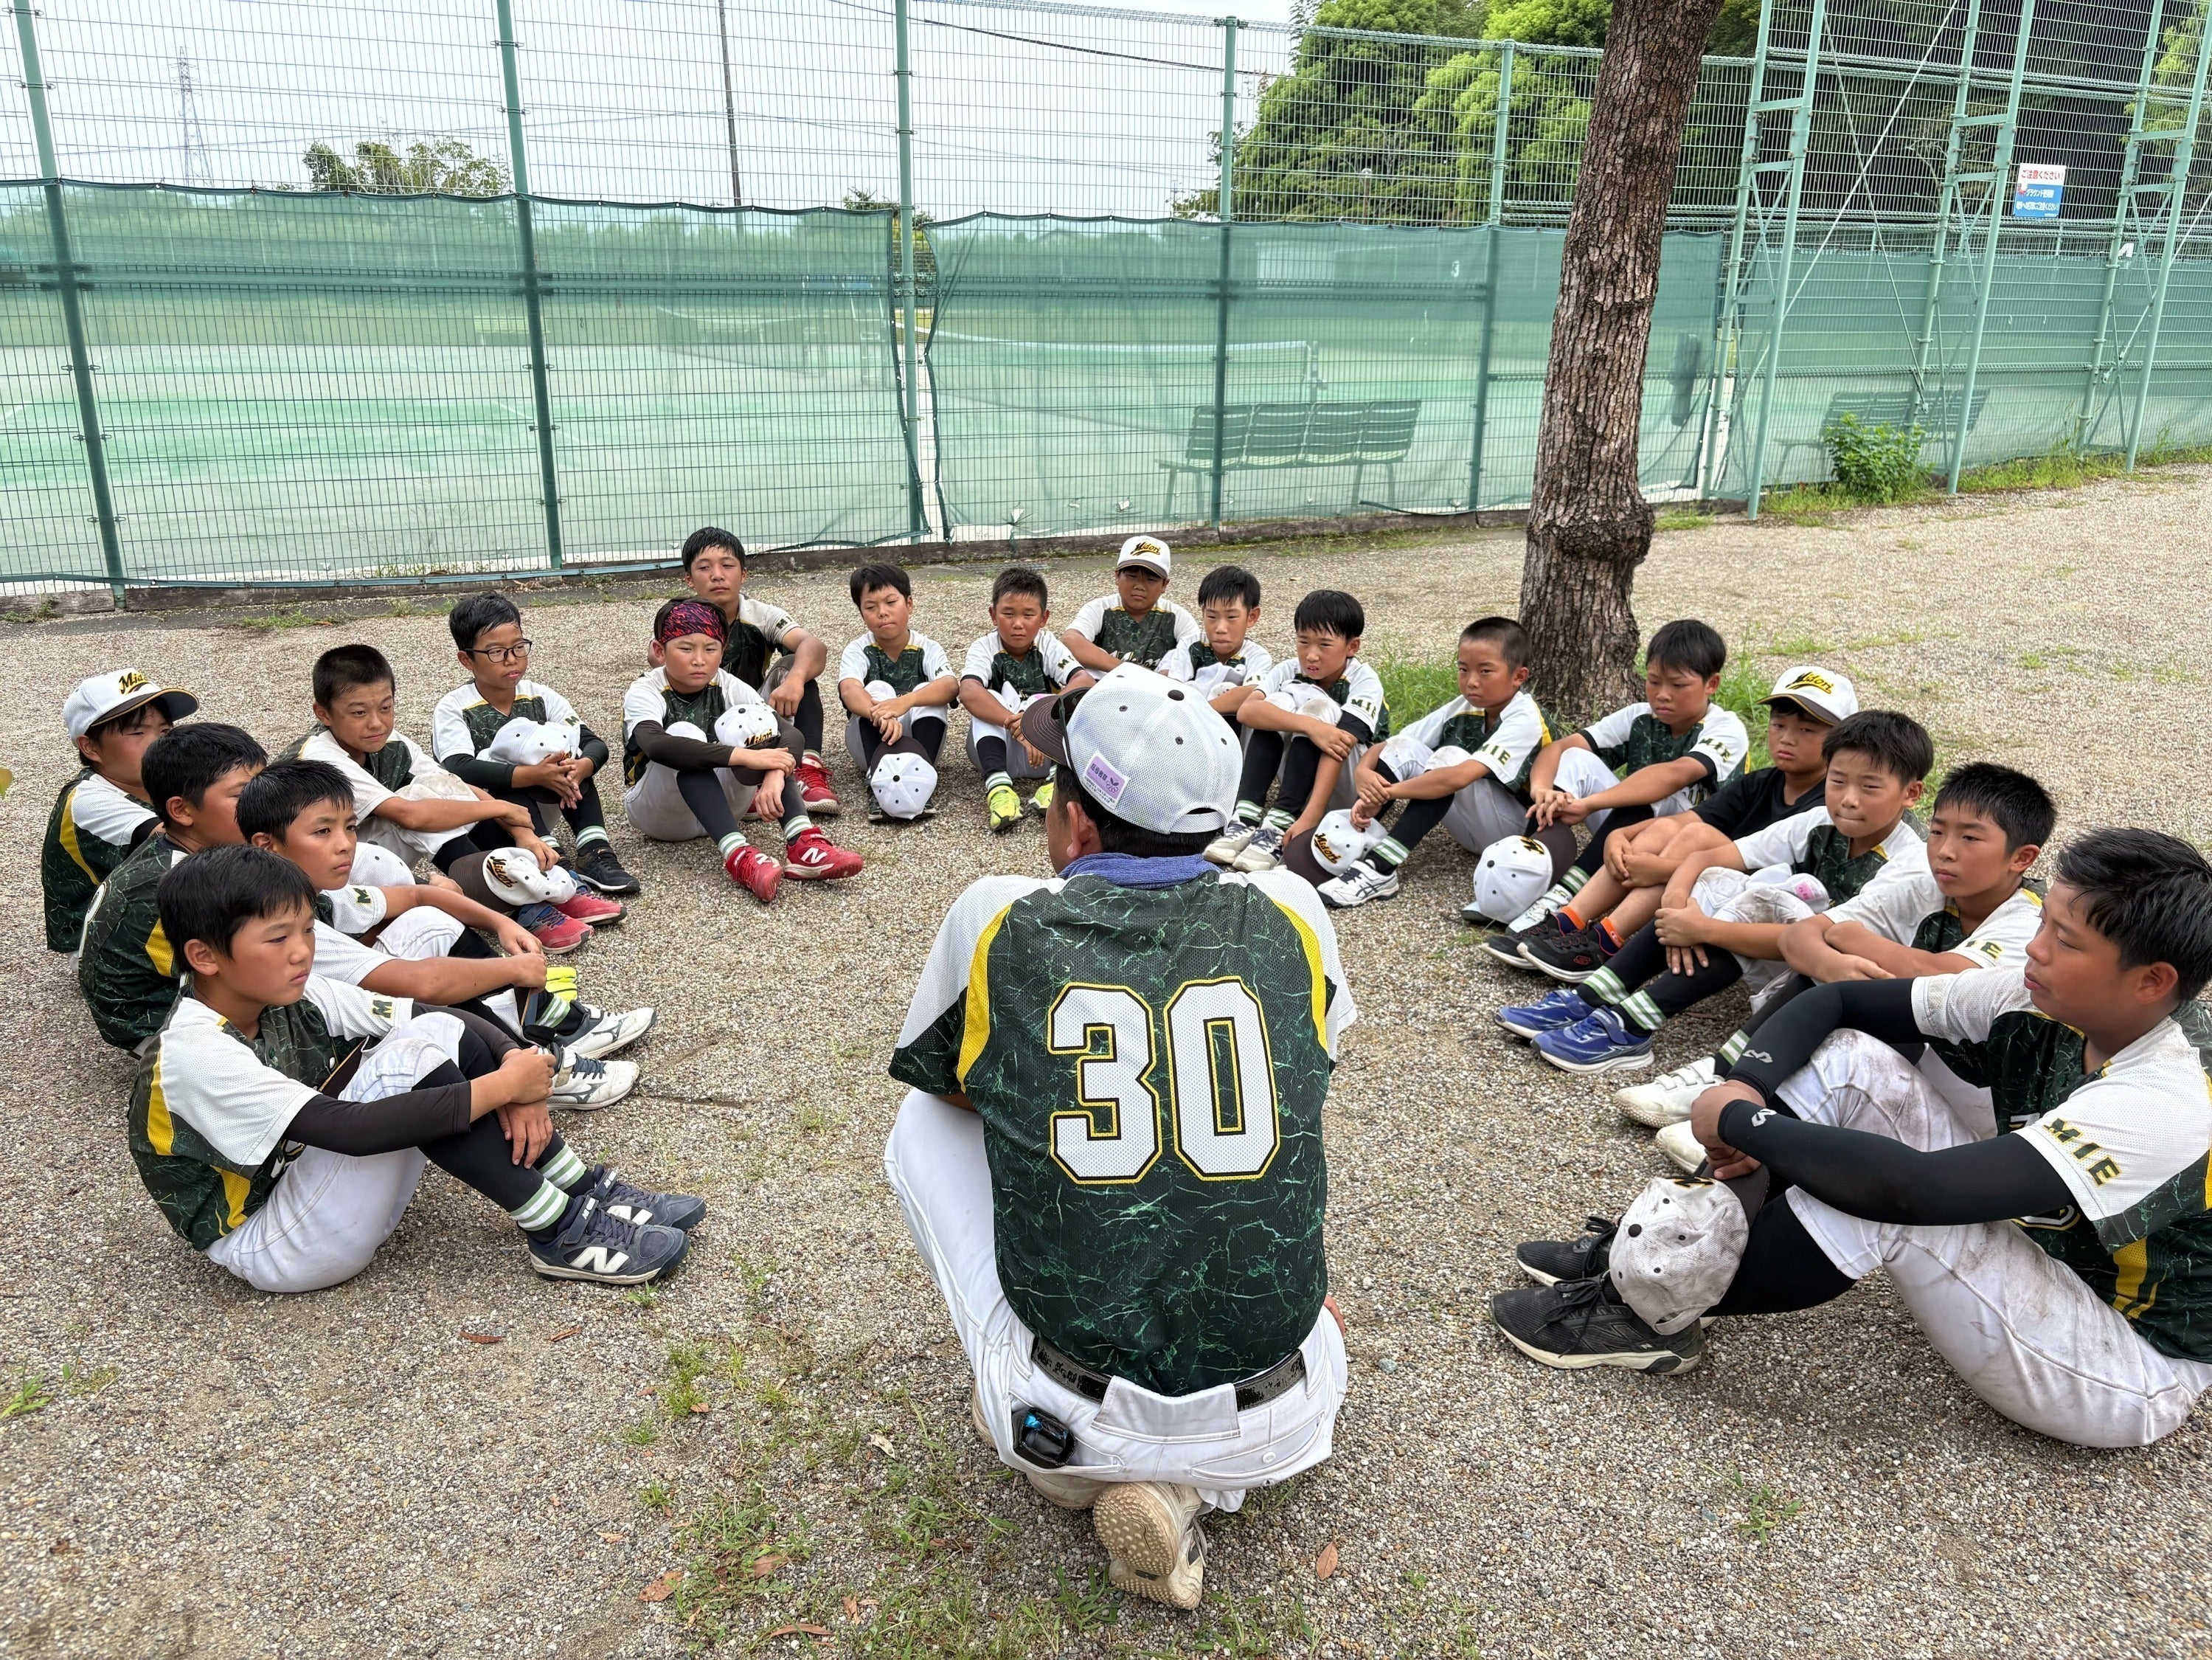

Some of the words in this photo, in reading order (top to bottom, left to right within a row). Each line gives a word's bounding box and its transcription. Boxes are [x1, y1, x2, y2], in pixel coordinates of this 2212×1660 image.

[1130, 542, 1161, 556] Midori
[1785, 671, 1834, 694] Midori
[1351, 698, 1376, 719] MIE
[744, 728, 773, 747] Midori
[1698, 738, 1731, 763] MIE
[1314, 832, 1341, 864] Midori
[487, 856, 518, 888] Midori
[1047, 975, 1280, 1185] 30
[2042, 1116, 2123, 1187] MIE
[569, 1246, 630, 1273] N
